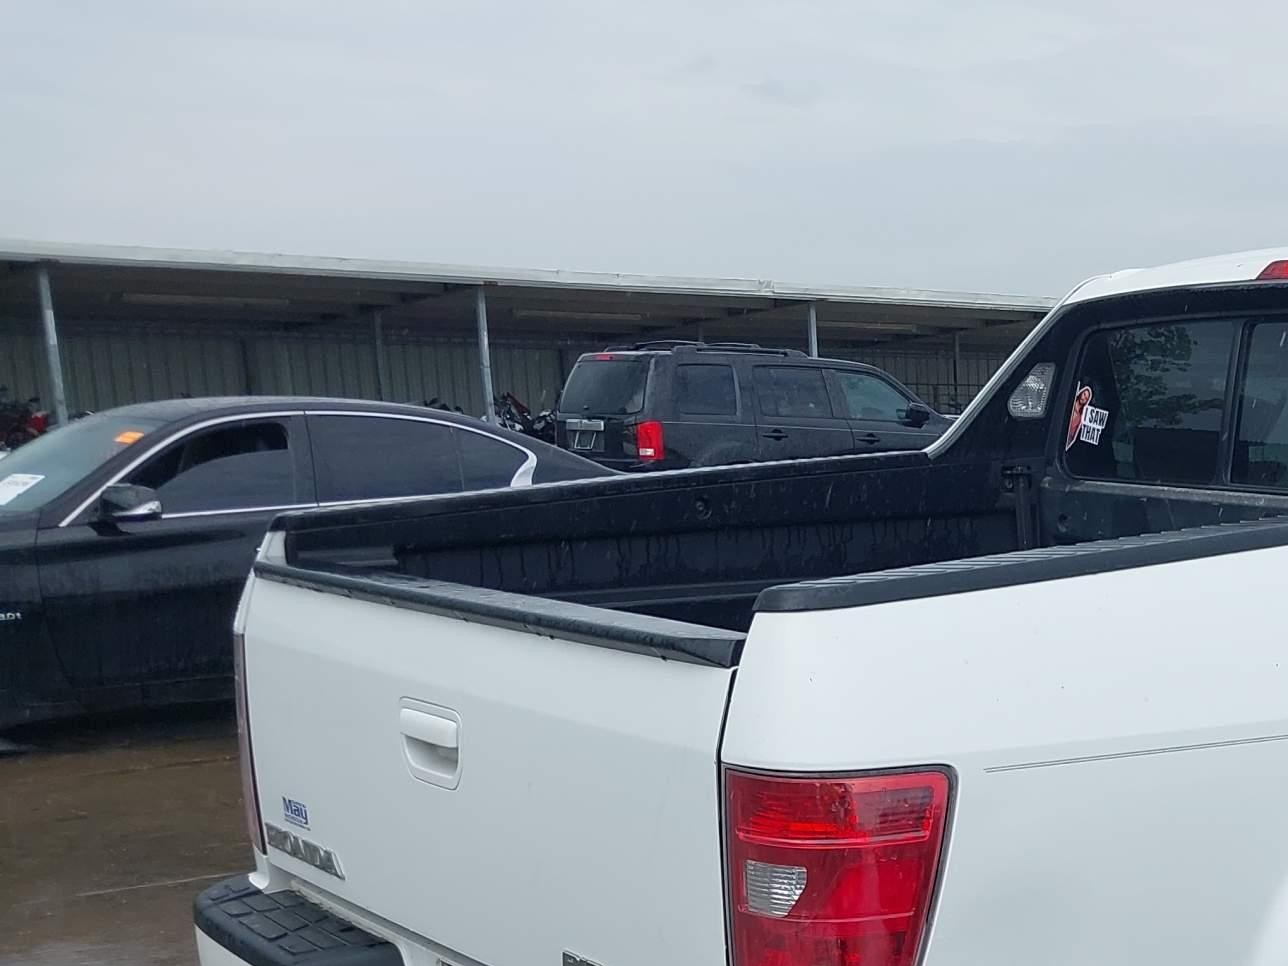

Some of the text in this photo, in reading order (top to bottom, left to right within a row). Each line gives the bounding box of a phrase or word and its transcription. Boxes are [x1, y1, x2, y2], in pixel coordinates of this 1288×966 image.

[1089, 408, 1107, 427] SAW
[1081, 424, 1101, 445] THAT
[282, 796, 309, 826] May
